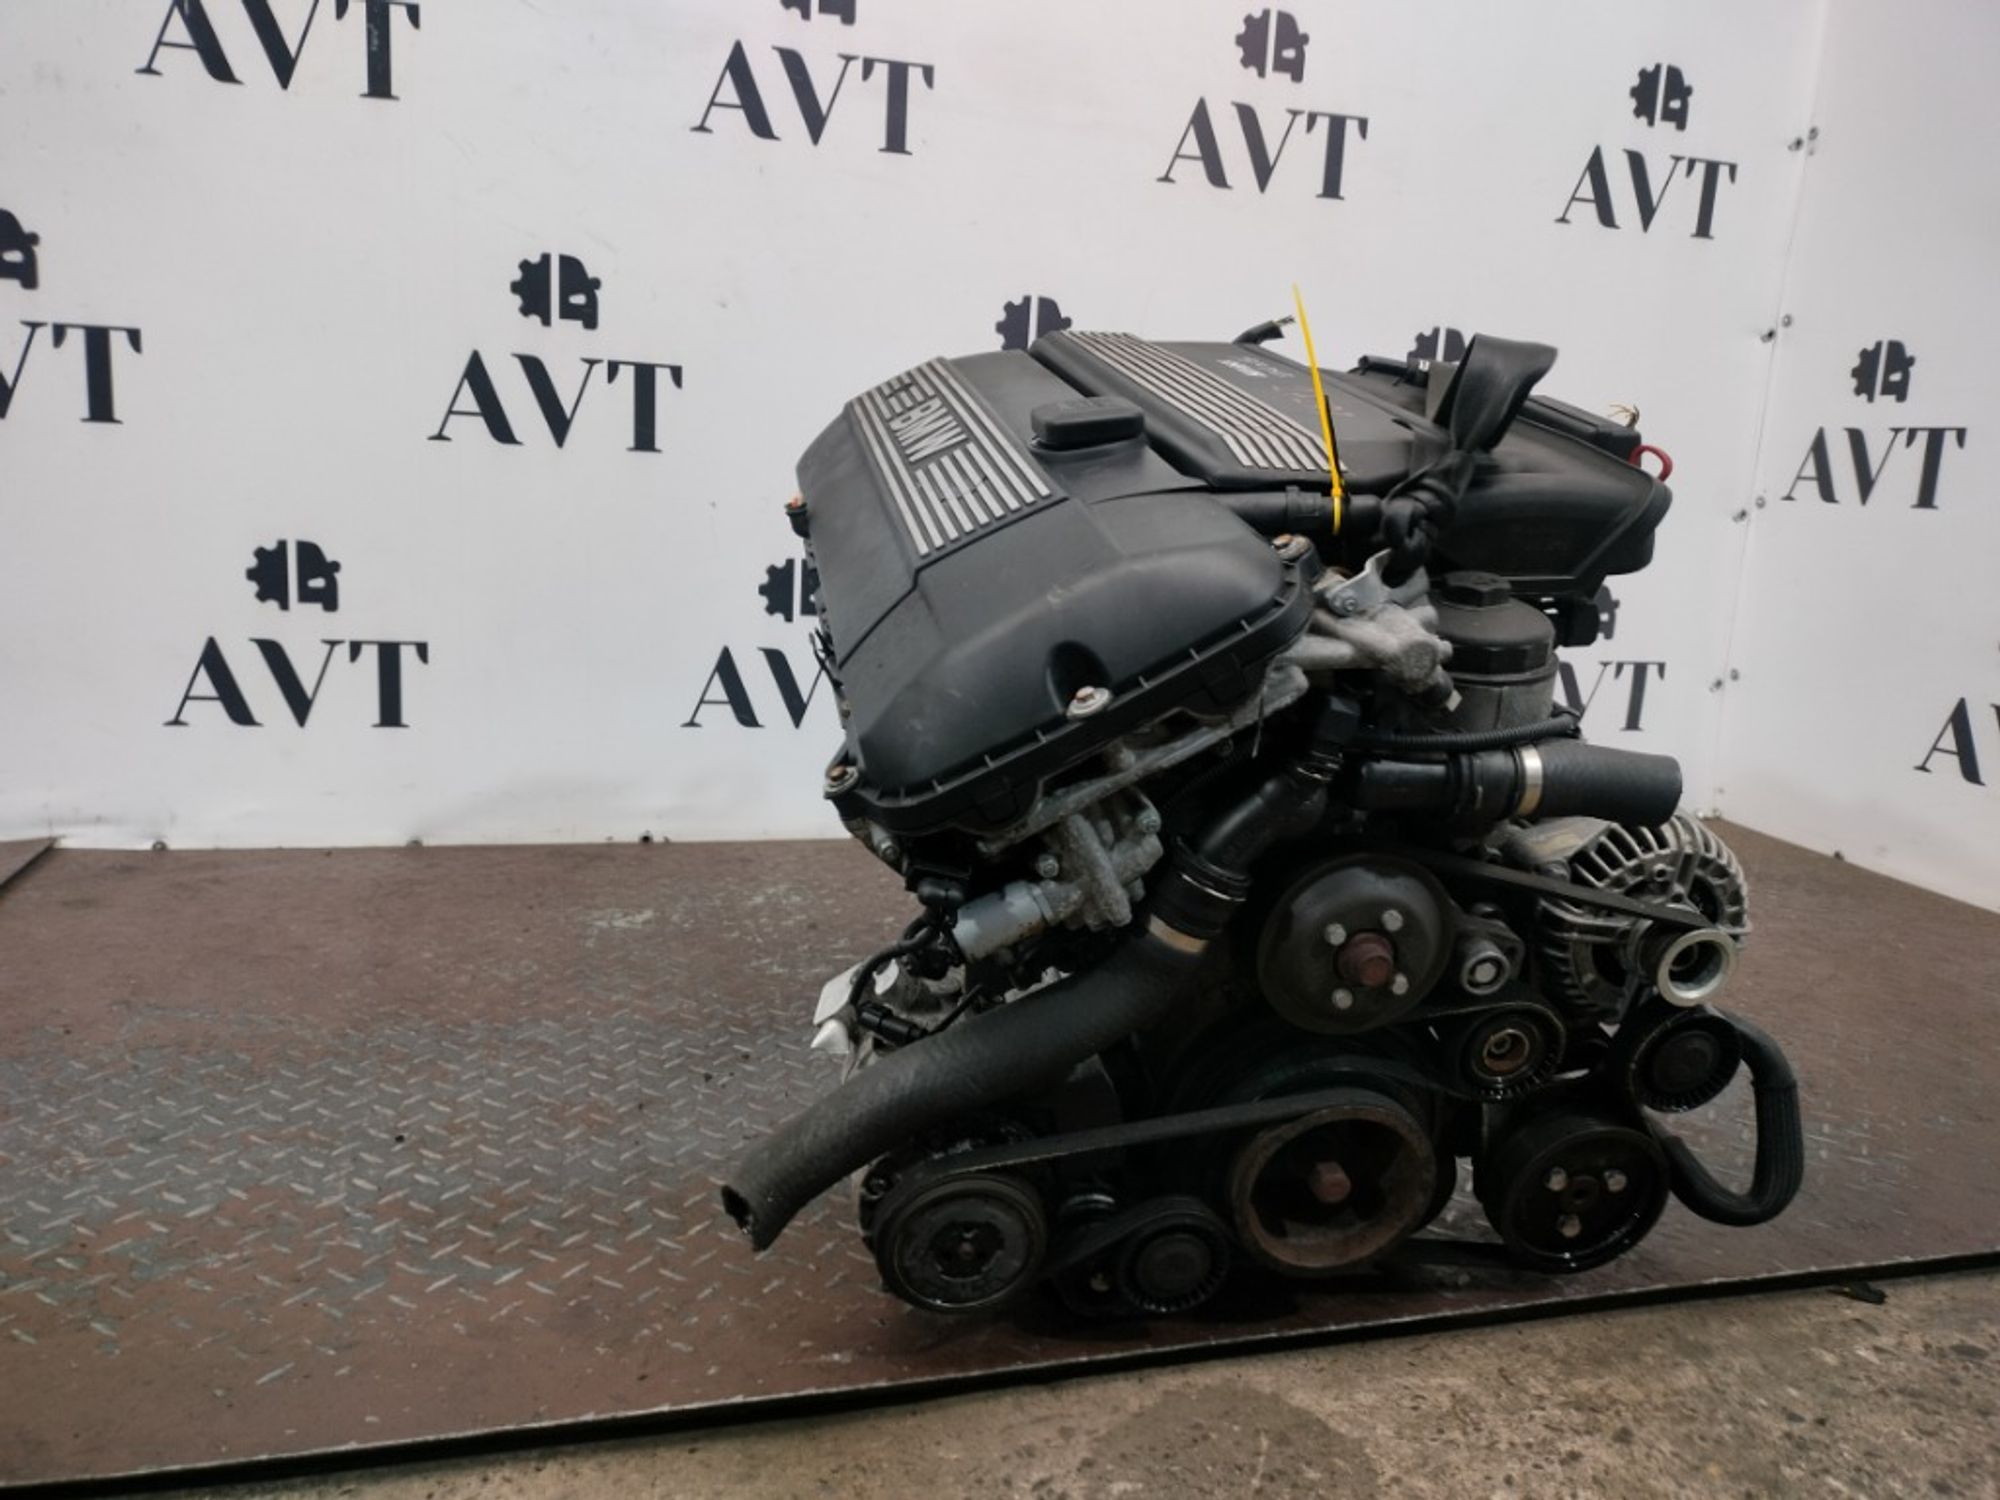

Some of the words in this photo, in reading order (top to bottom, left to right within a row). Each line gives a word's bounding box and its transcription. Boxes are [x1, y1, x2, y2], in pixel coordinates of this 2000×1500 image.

[135, 0, 420, 101] AVT
[690, 40, 934, 155] AVT
[1157, 97, 1368, 200] AVT
[1555, 145, 1738, 239] AVT
[427, 349, 683, 454] AVT
[889, 398, 967, 462] BMW
[1781, 427, 1967, 510] AVT
[162, 636, 429, 728] AVT
[680, 645, 826, 729] AV
[1559, 661, 1666, 731] VT
